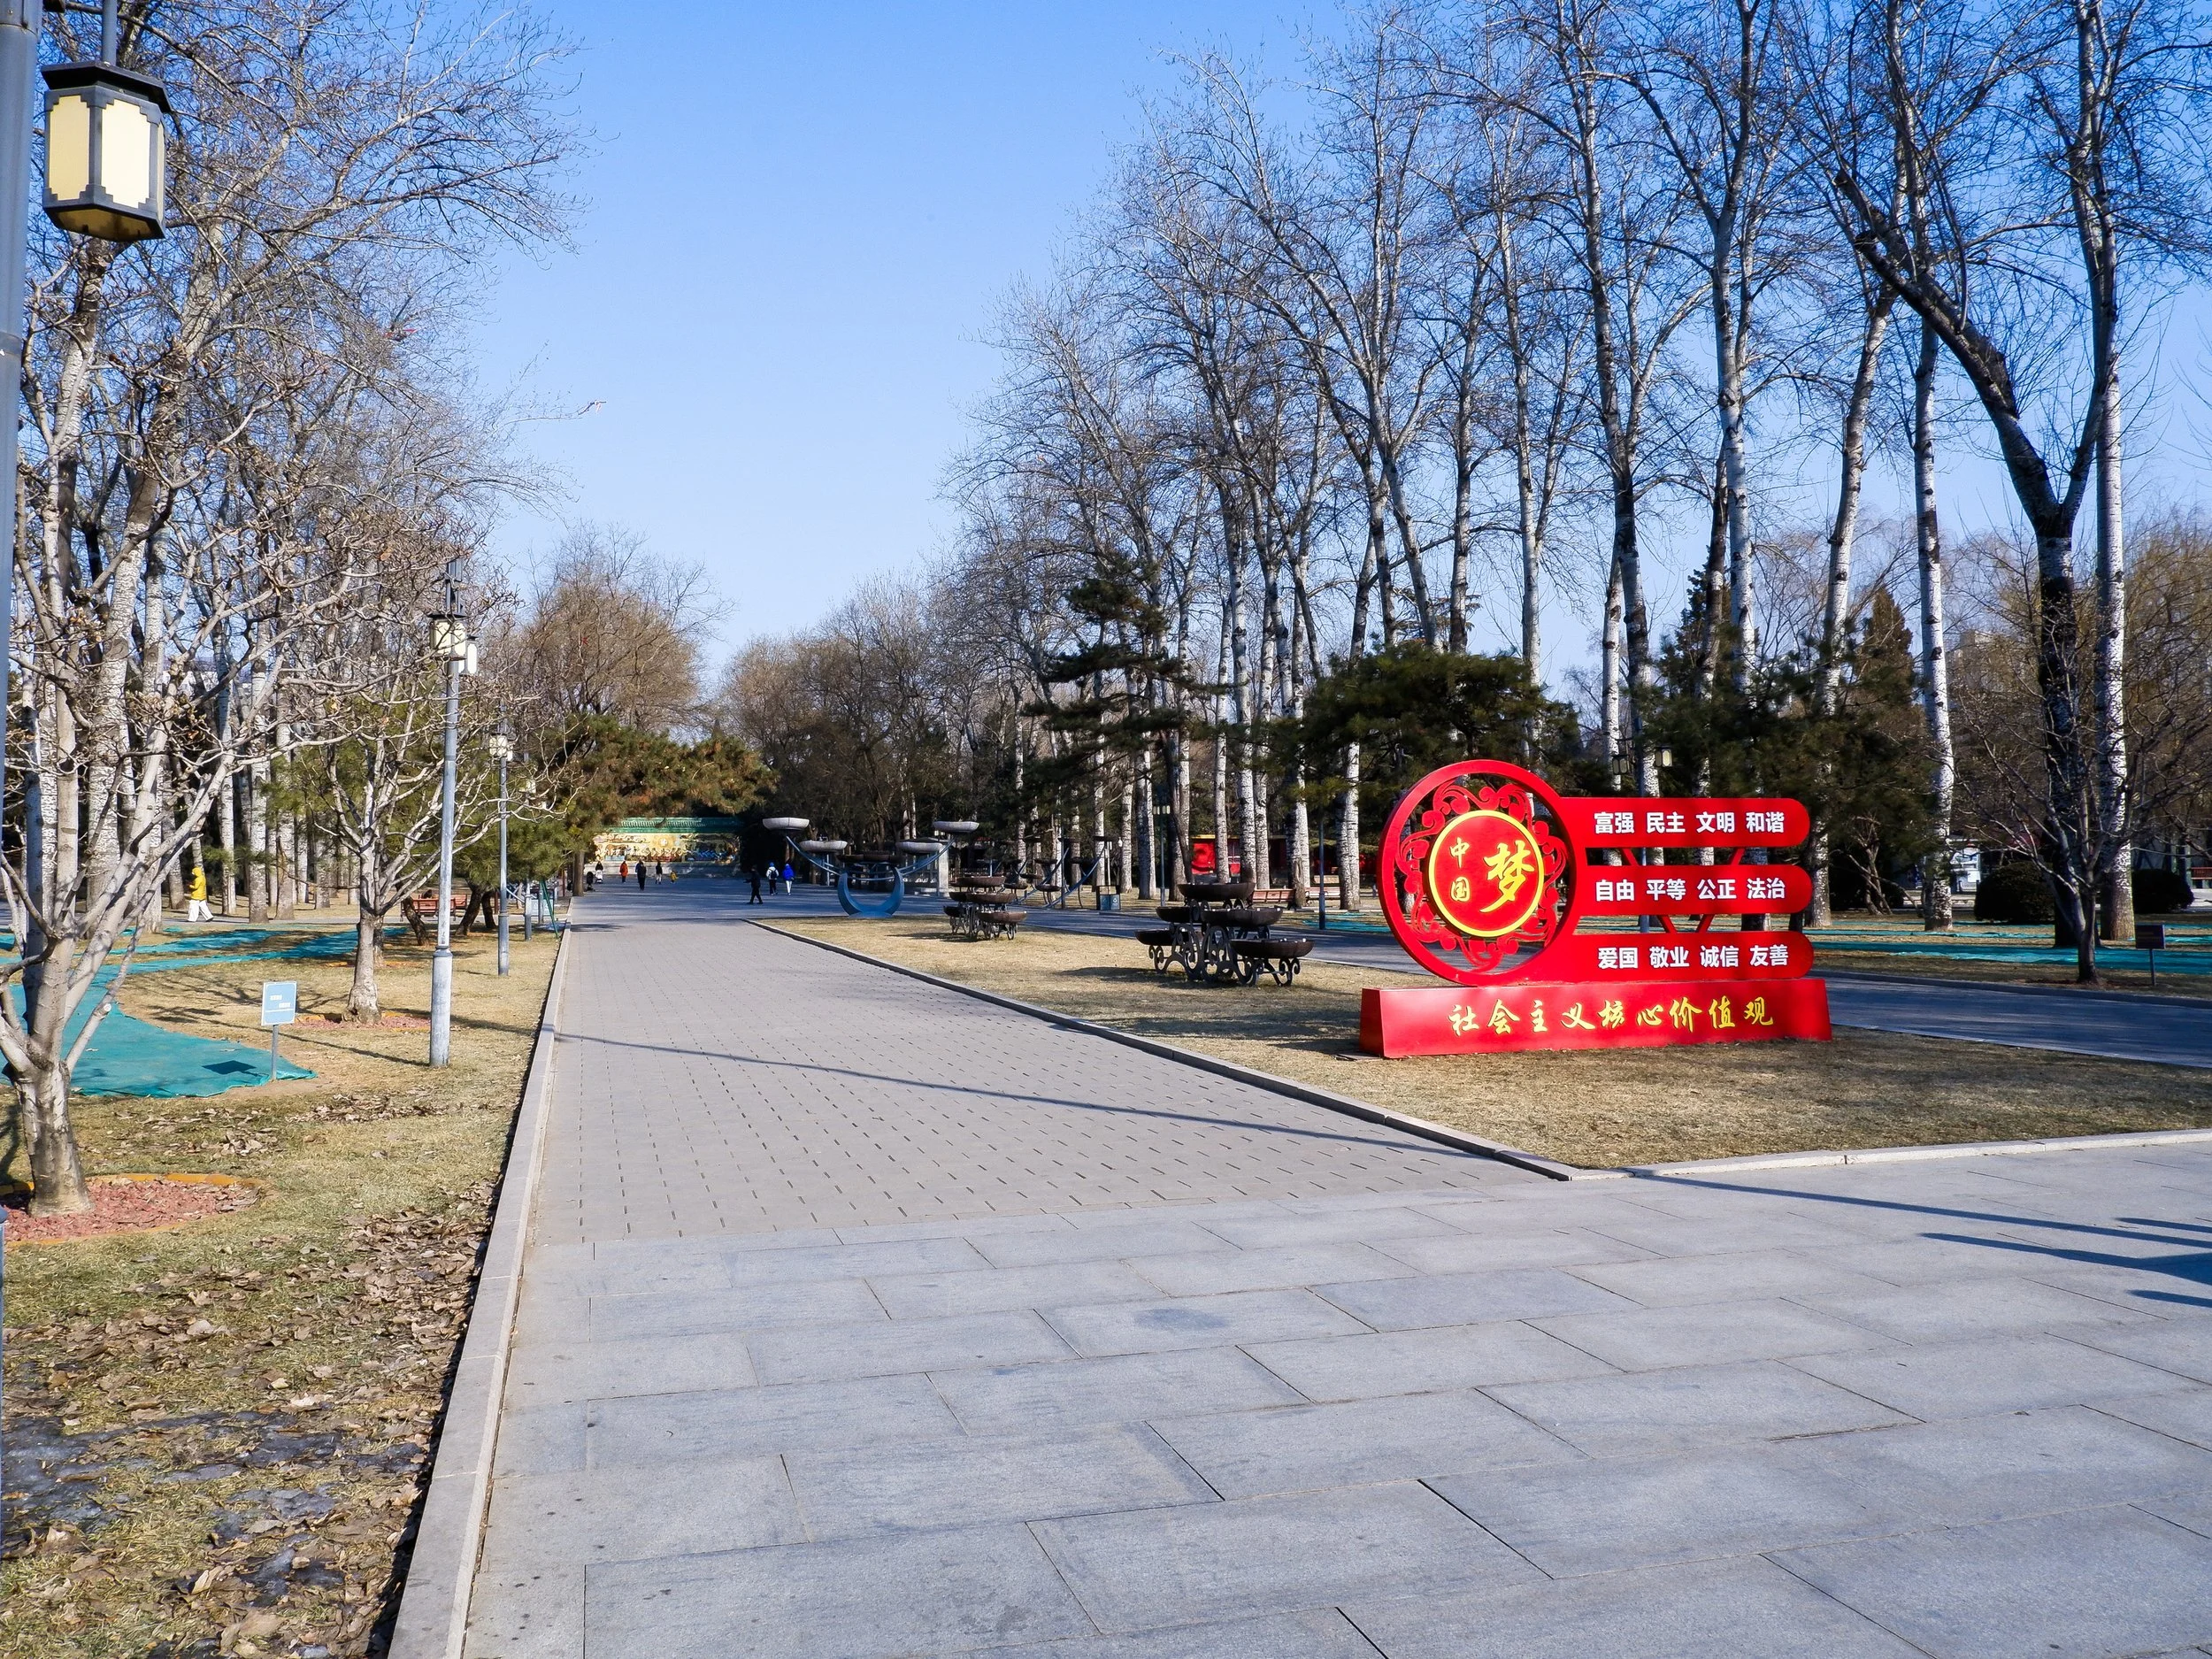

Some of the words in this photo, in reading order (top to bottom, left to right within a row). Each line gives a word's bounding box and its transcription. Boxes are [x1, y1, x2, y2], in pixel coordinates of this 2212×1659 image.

[1594, 810, 1635, 834] 富强
[1646, 810, 1686, 833] 民主
[1695, 810, 1735, 833] 文明
[1746, 810, 1785, 833] 和谐
[1595, 879, 1635, 902] 自由
[1646, 878, 1686, 901] 平等
[1696, 879, 1737, 900] 公正
[1747, 877, 1786, 900] 法治
[1598, 947, 1639, 970] 爱国
[1648, 946, 1690, 969] 敬业
[1700, 945, 1740, 968] 诚信
[1749, 943, 1789, 967] 友善
[1448, 995, 1774, 1035] 社会主义核心价值观
